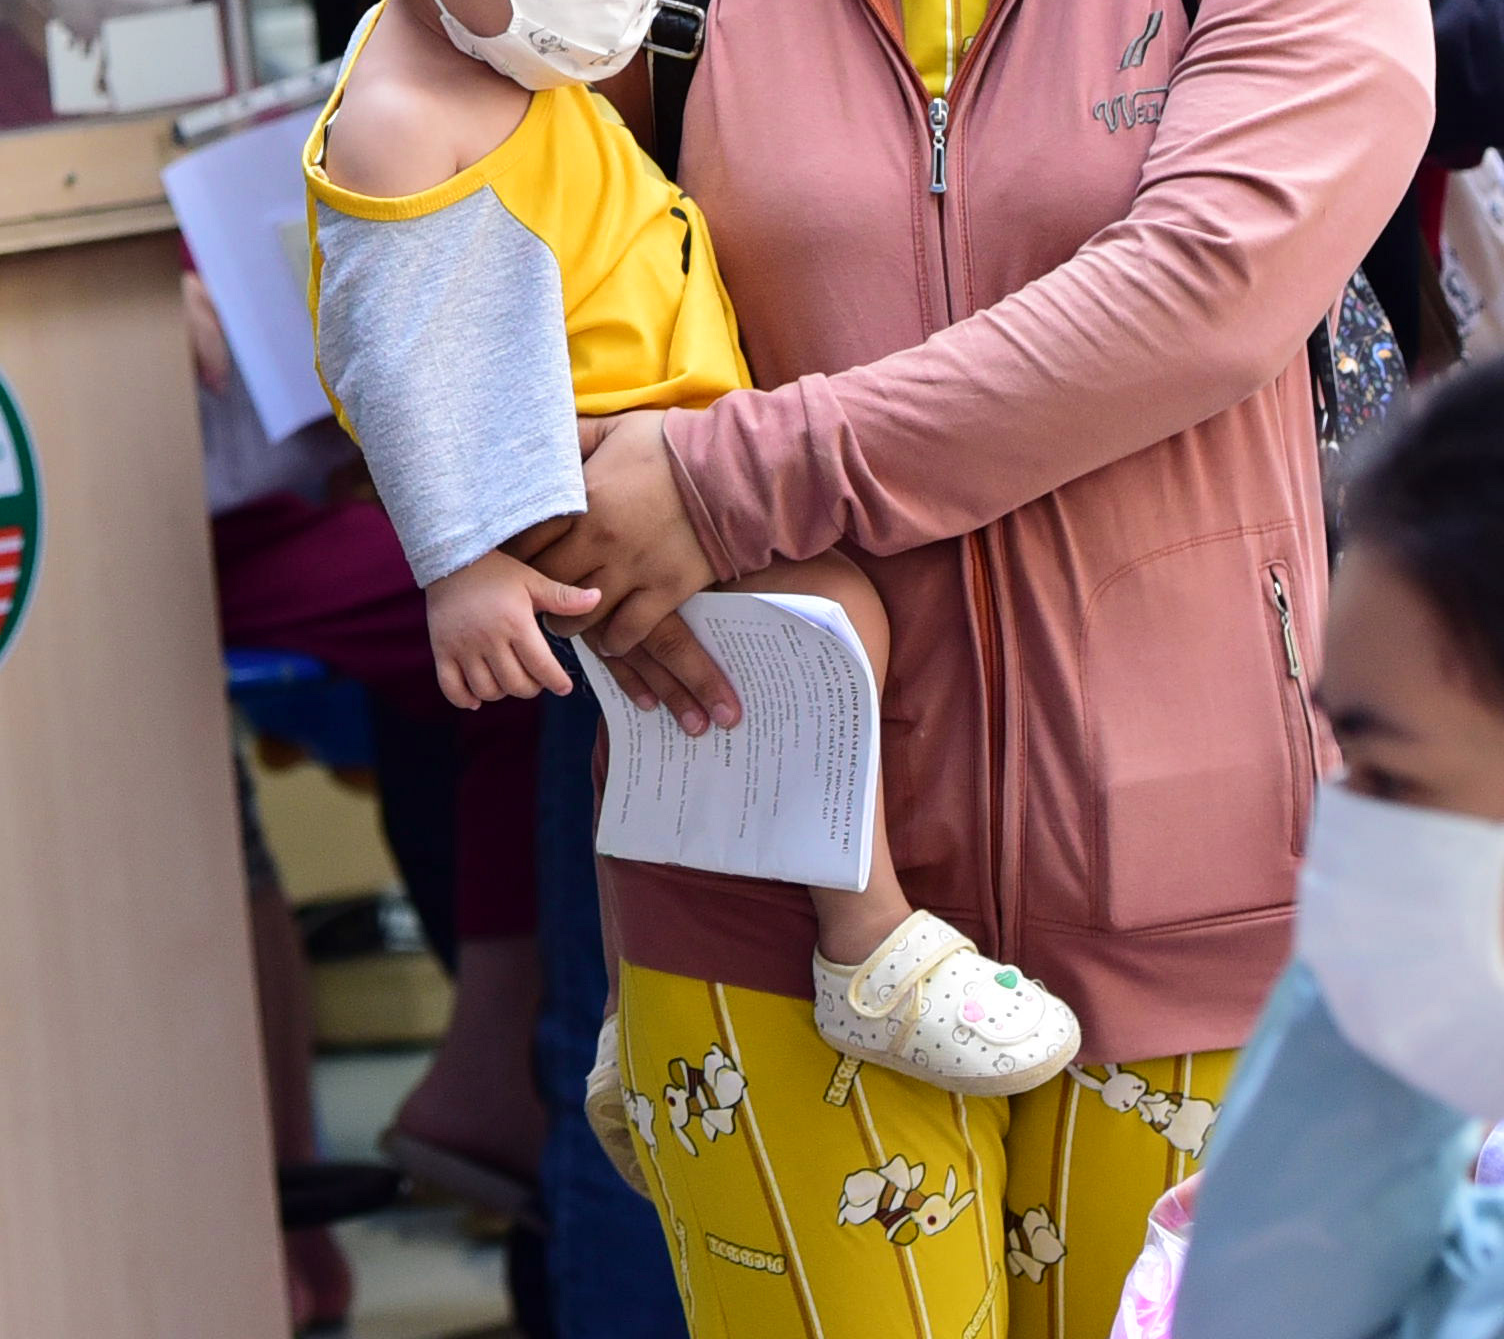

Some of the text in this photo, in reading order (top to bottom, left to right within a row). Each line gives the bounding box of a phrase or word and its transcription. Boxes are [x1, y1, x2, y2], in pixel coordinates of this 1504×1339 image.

[848, 681, 859, 710] HÌNH
[851, 713, 861, 750] KHÁM
[837, 741, 845, 758] EM
[832, 768, 842, 804] PHÒNG
[847, 753, 858, 786] BỆNH
[829, 807, 839, 840] KHÁM
[843, 789, 854, 827] NGOẠI
